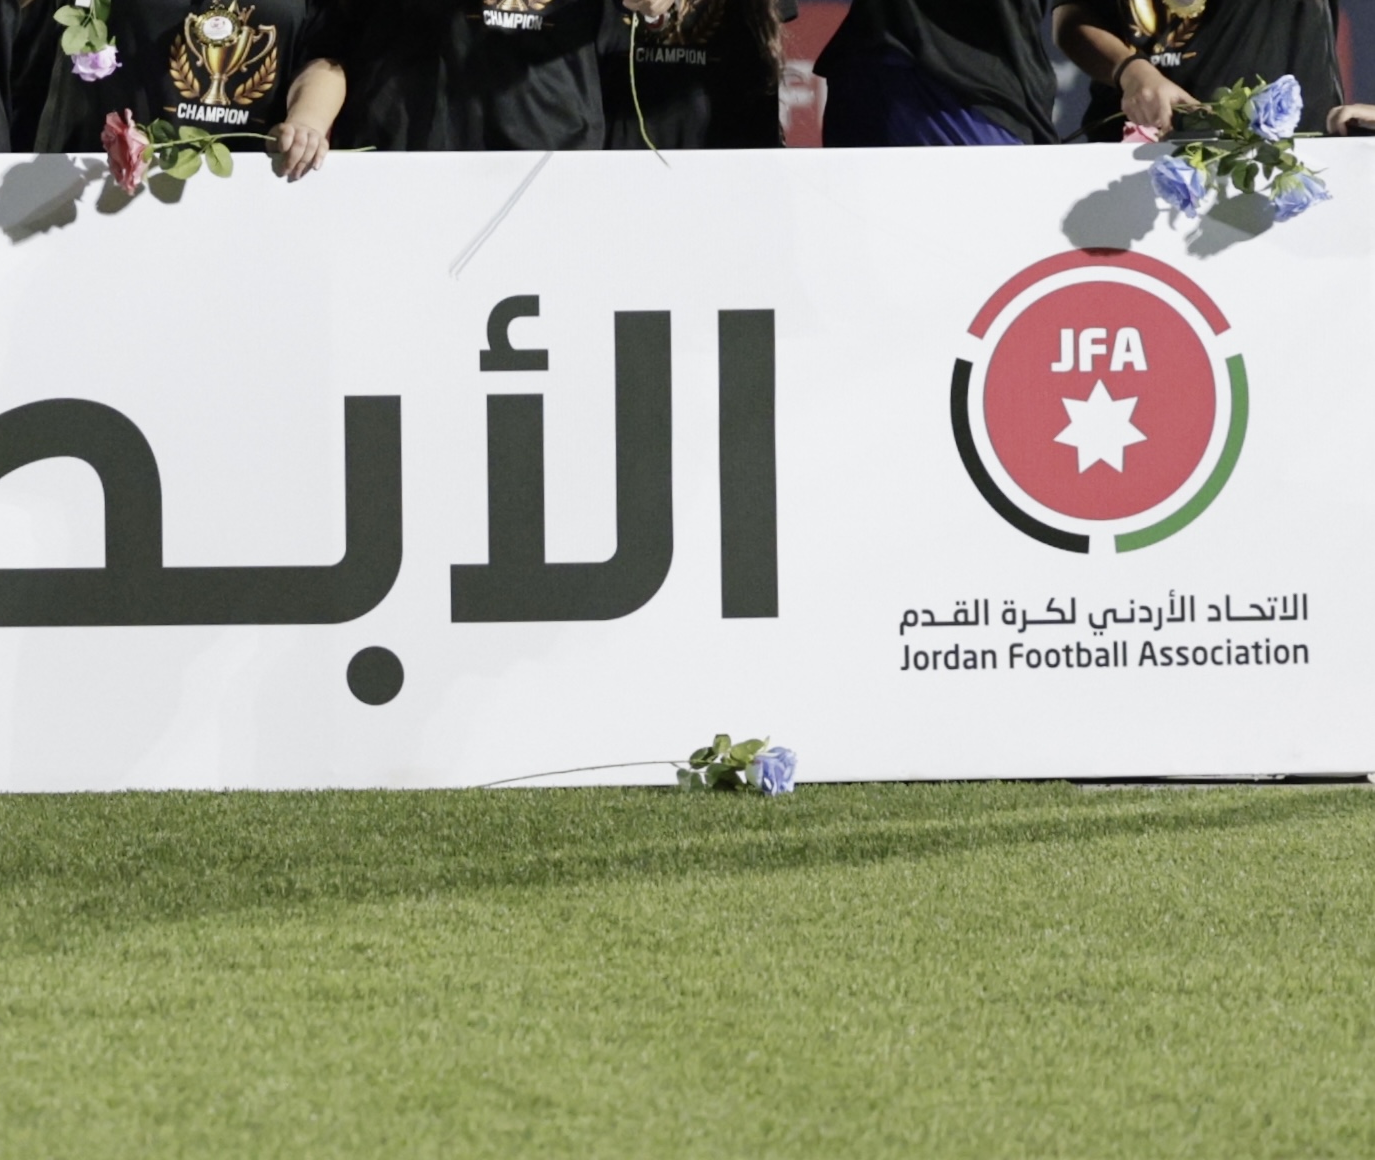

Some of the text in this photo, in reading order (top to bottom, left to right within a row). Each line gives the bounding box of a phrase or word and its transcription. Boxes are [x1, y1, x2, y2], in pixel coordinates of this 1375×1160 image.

[483, 10, 543, 31] CHAMPION
[636, 47, 707, 66] CHAMPION
[177, 103, 249, 125] CHAMPION
[1050, 327, 1149, 373] JFA
[899, 590, 1309, 636] الاتحاد الأردني لكرة القدم
[900, 637, 1310, 671] Jordan Football Association
